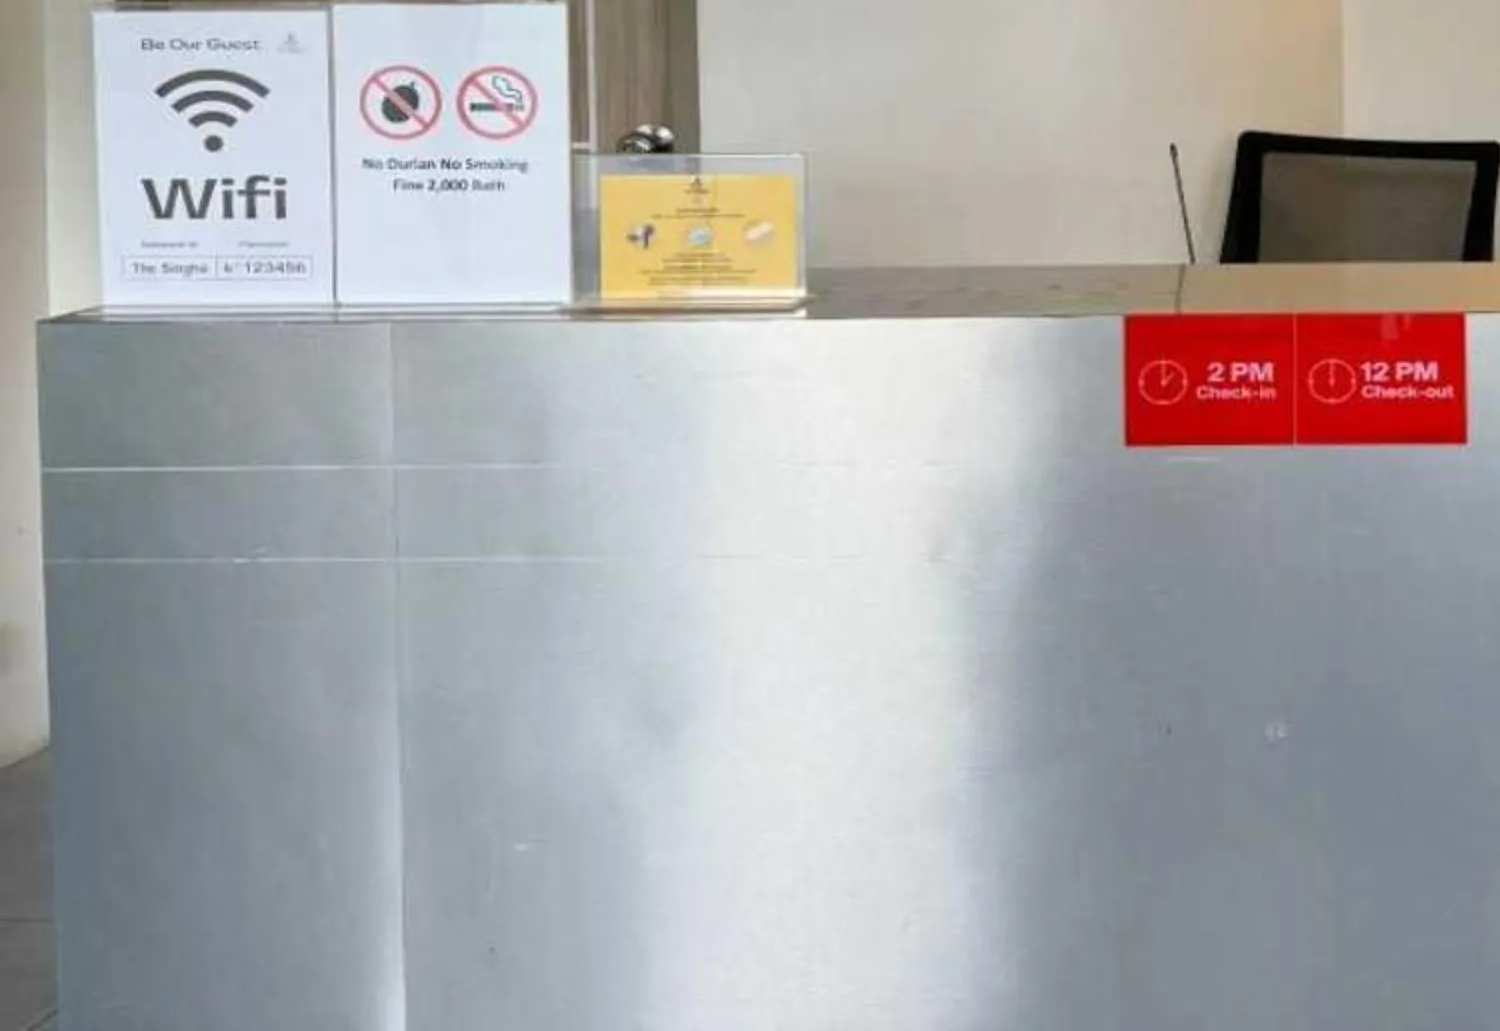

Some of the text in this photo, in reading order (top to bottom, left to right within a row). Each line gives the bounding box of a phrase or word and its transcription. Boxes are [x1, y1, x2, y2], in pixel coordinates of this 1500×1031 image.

[140, 37, 260, 51] Be Our Guest
[362, 157, 529, 174] No Durian No Smoking
[393, 179, 424, 191] Fine
[140, 174, 288, 220] Wifi
[1207, 362, 1275, 383] 2 PM
[1360, 361, 1439, 382] 12 PM
[1196, 385, 1277, 401] Check-in
[1361, 384, 1455, 400] Check-out
